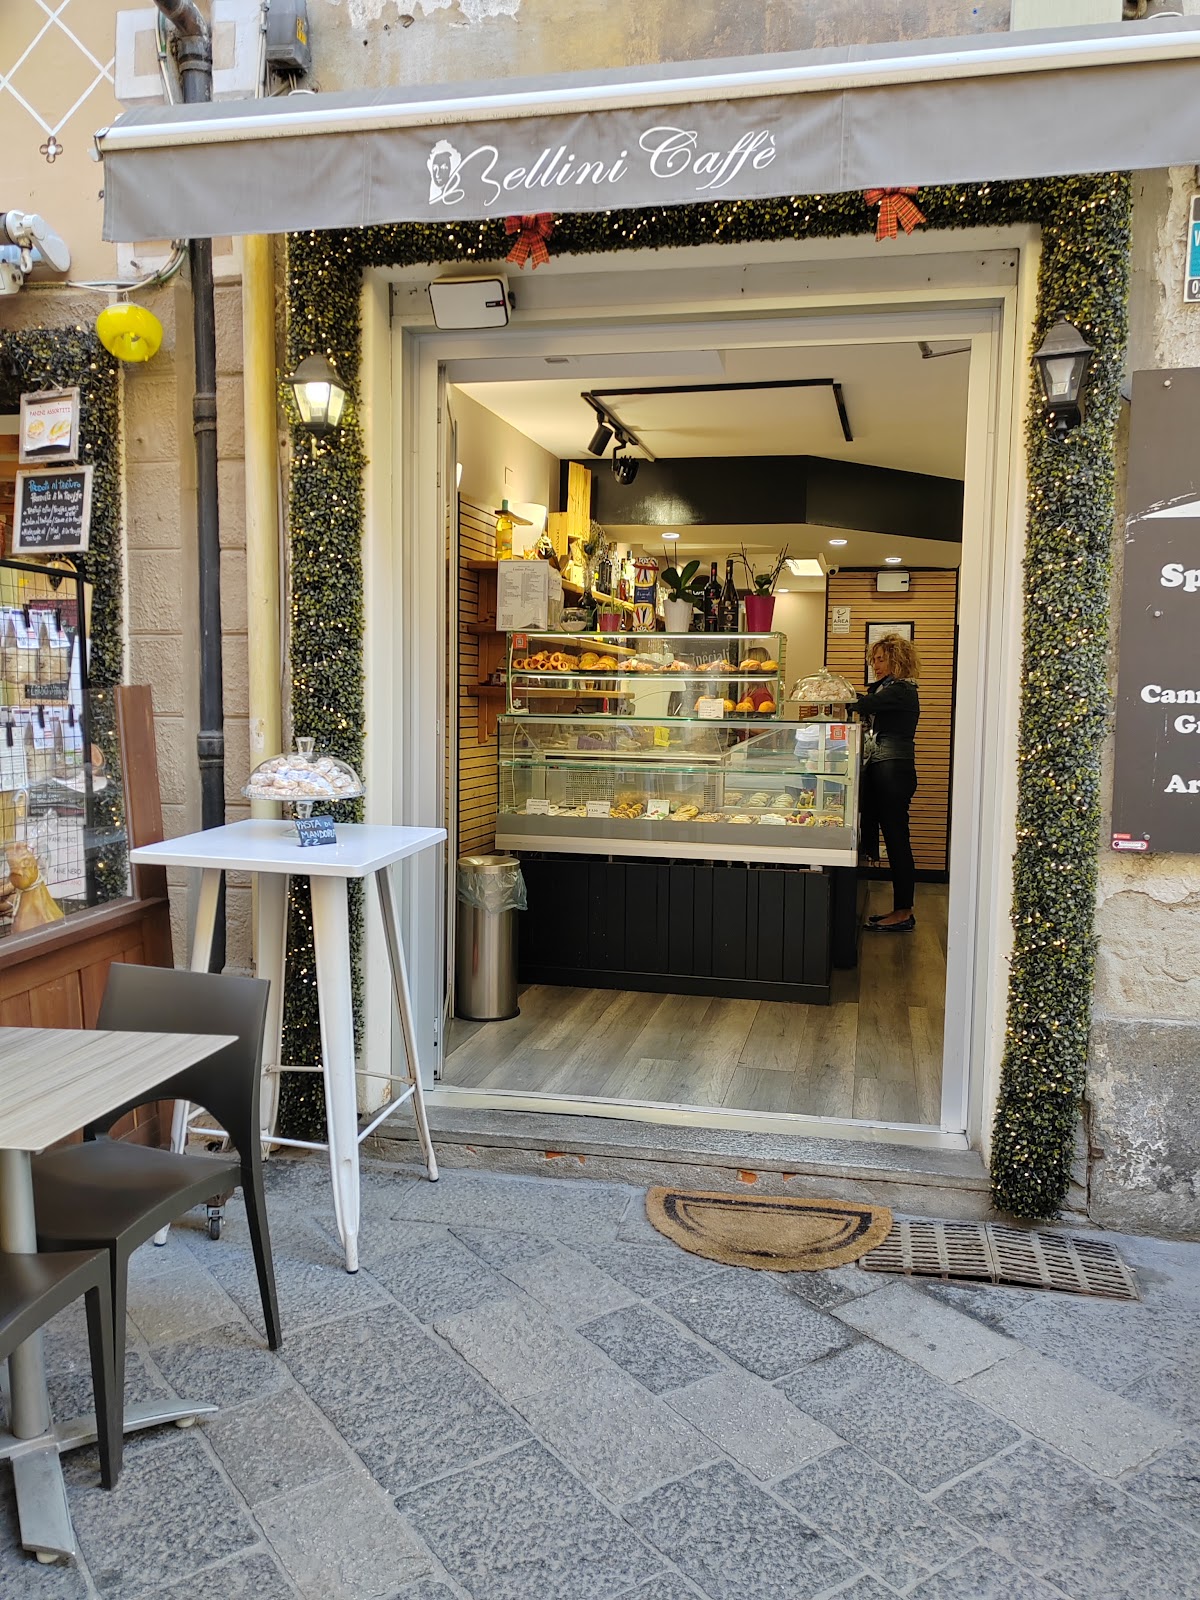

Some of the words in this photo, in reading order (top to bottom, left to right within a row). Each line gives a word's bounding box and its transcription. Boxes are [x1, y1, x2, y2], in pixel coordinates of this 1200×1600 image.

[437, 144, 628, 206] Bellini
[639, 126, 776, 191] Caffè
[29, 409, 46, 417] PANINI
[47, 407, 71, 415] ASSORTITI
[295, 819, 321, 830] PASTA
